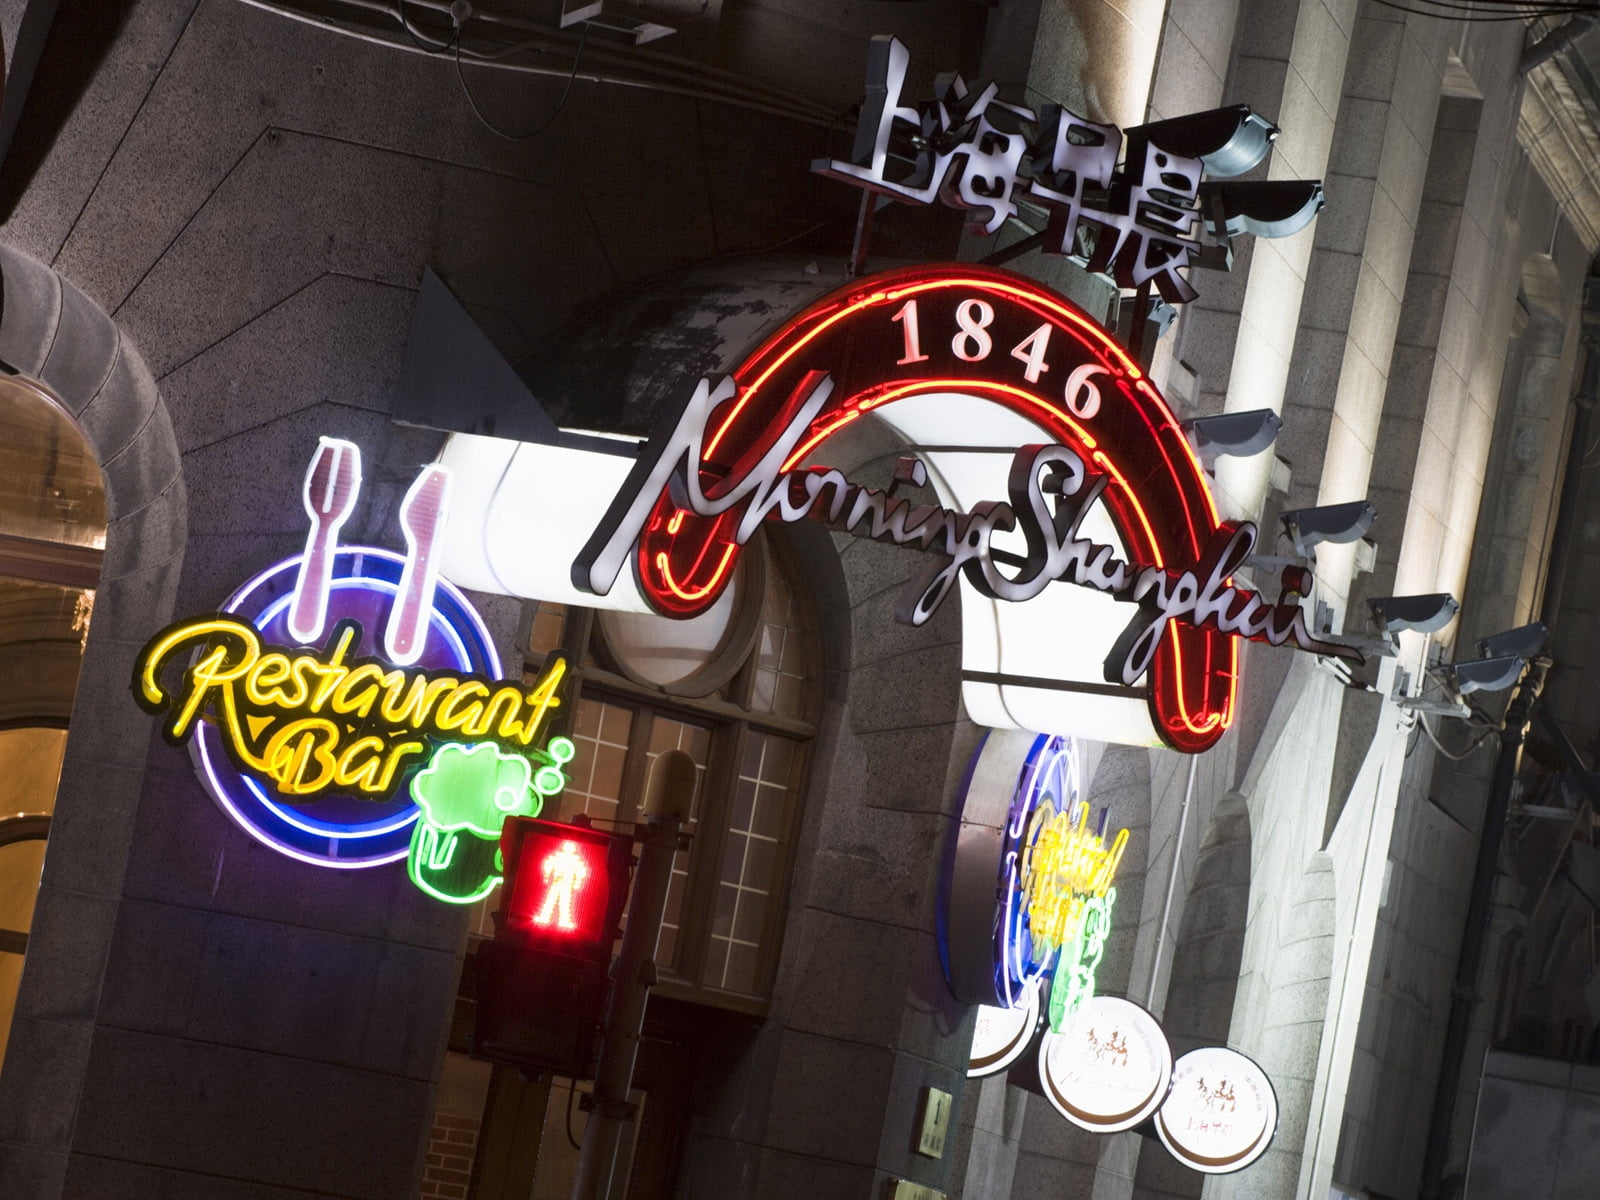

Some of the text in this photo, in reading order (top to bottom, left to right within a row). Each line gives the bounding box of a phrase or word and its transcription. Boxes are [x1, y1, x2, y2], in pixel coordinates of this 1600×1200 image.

[891, 298, 1111, 420] 1846
[585, 372, 1364, 687] Morning Shanghai
[142, 619, 567, 795] Restaurant Bar
